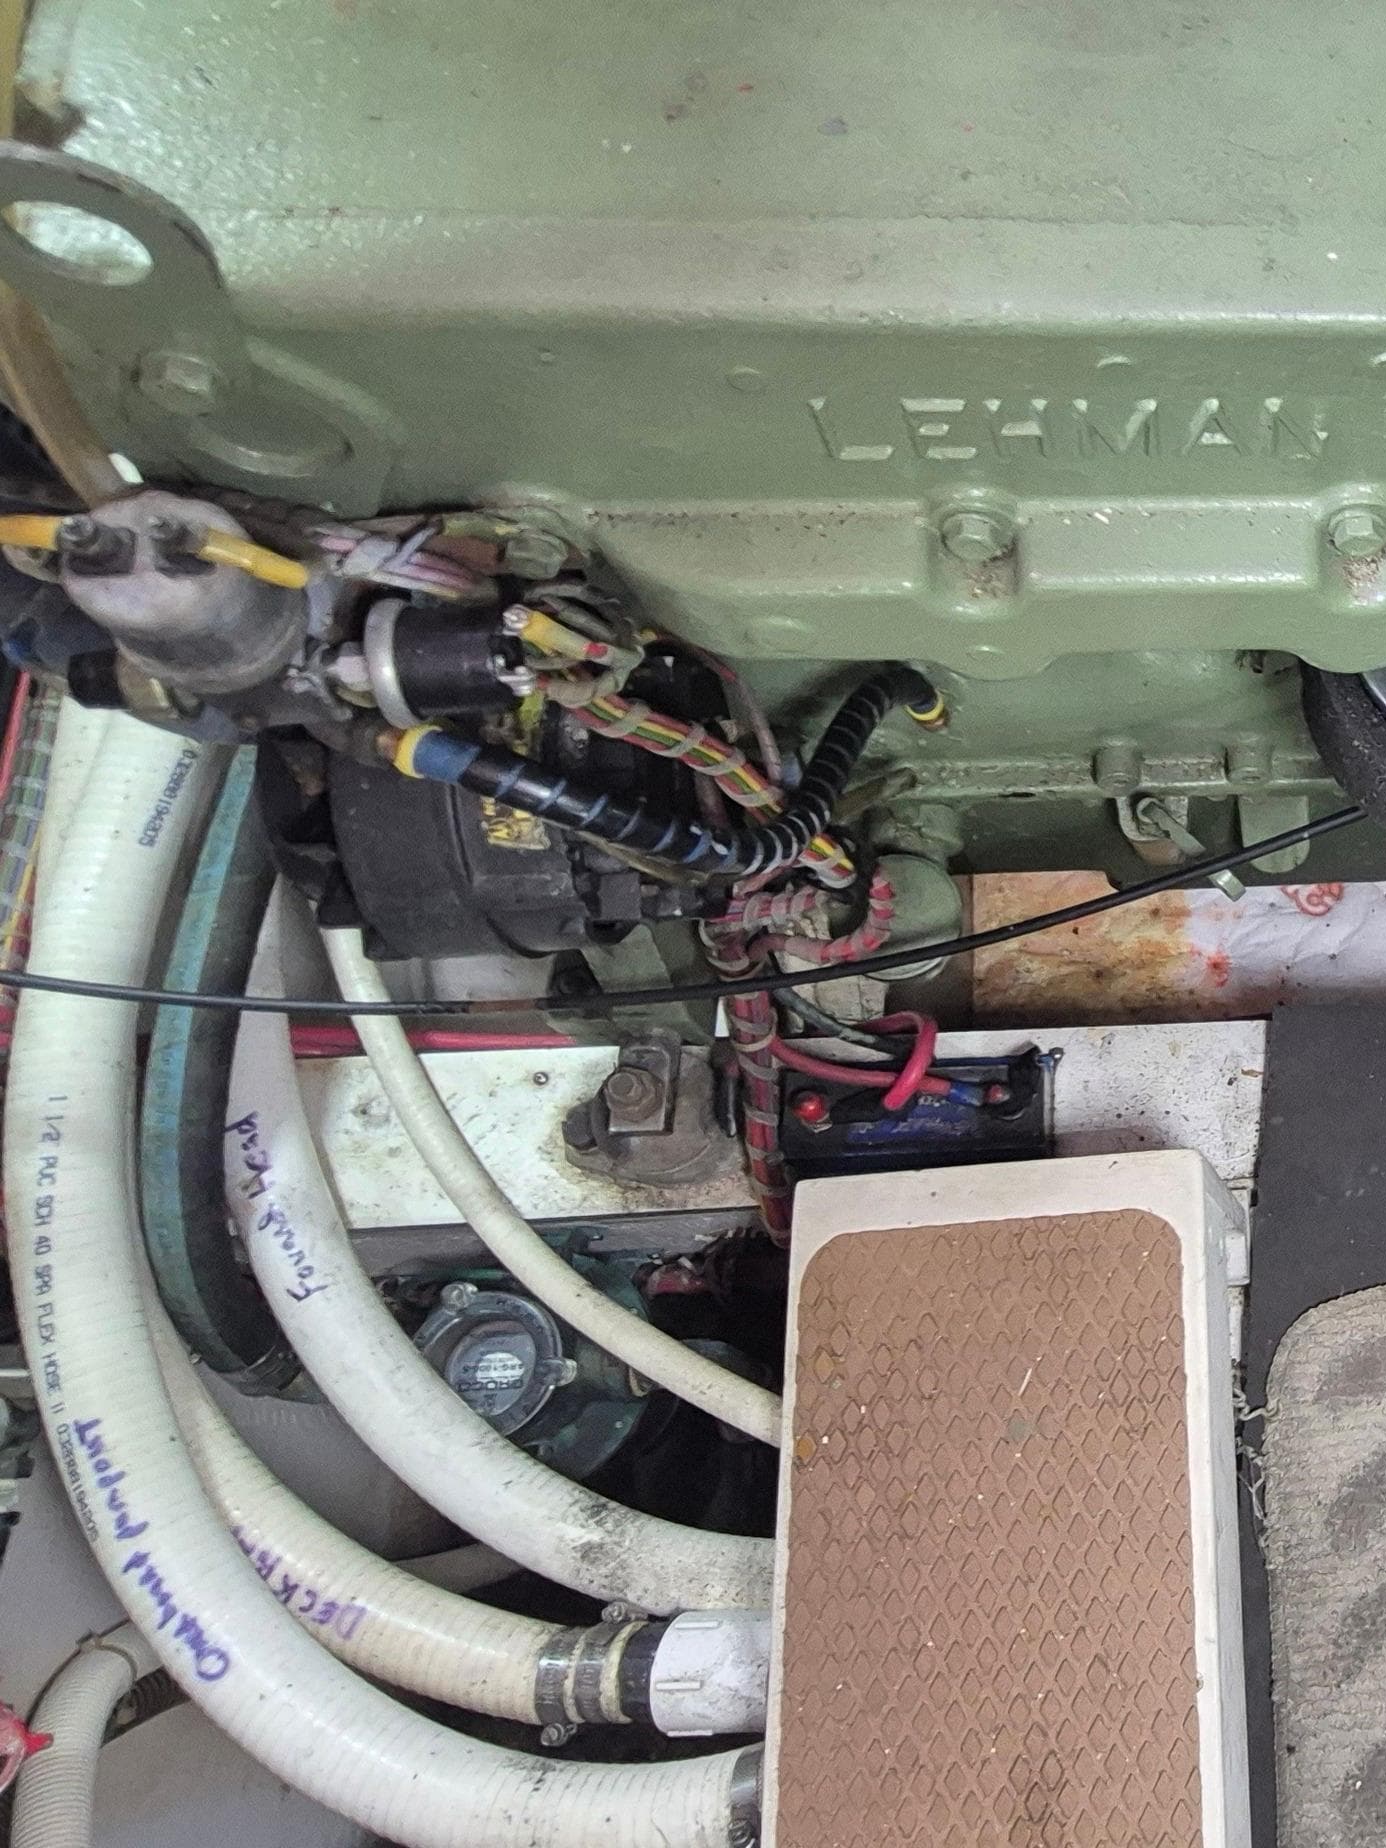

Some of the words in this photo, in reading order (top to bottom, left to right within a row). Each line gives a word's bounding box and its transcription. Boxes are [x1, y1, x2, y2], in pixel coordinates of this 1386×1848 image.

[806, 396, 1330, 461] LEHMAN
[34, 1234, 52, 1256] 40
[34, 1263, 53, 1297] SPA
[36, 1302, 55, 1345] FLEX
[271, 1573, 368, 1642] DECK
